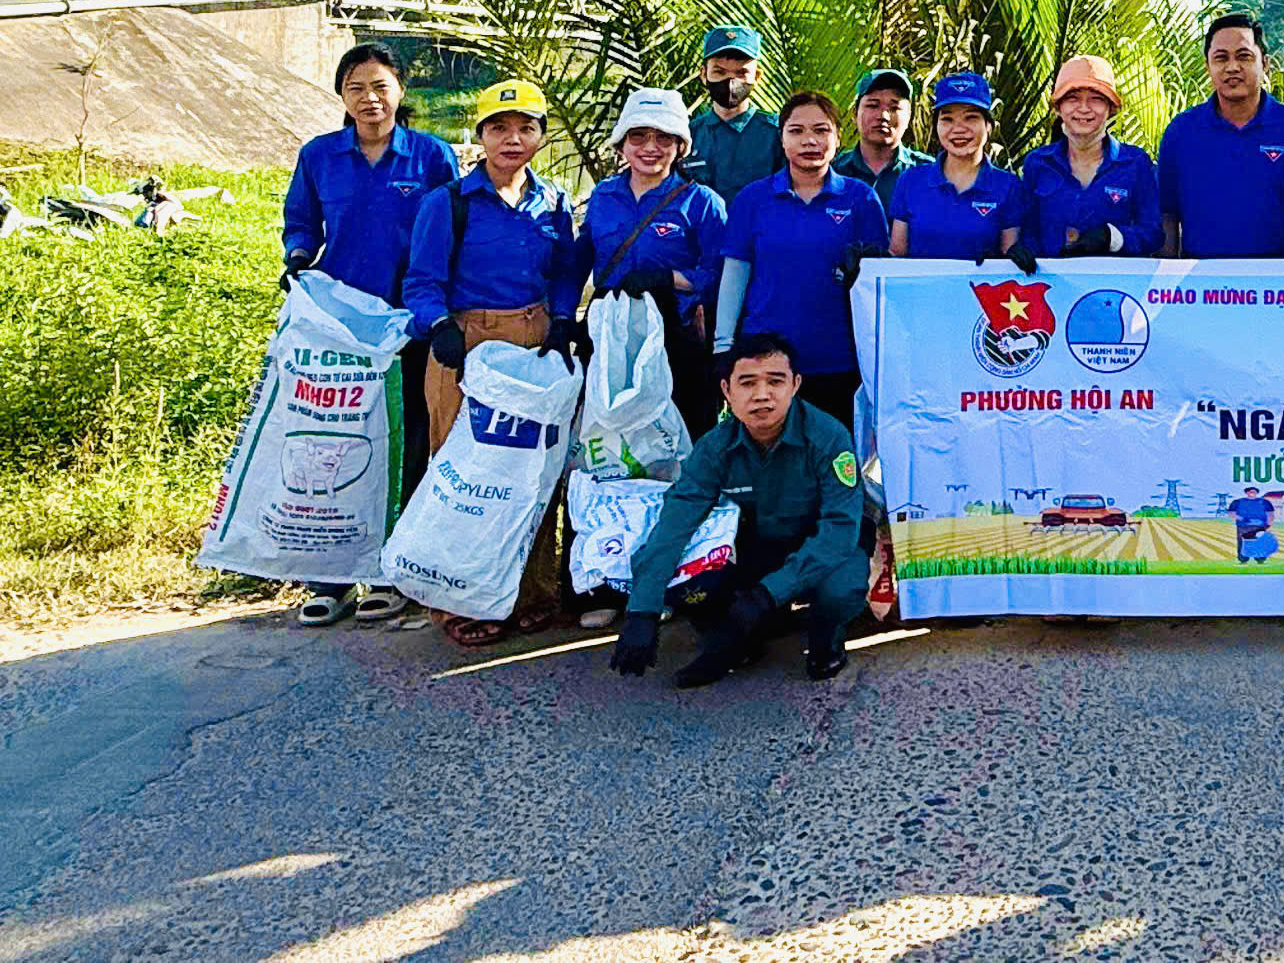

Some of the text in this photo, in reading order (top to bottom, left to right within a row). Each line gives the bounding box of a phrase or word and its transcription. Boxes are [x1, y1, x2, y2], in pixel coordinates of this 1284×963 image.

[1147, 286, 1197, 304] CHÀO
[1203, 285, 1258, 305] MỪNG
[1082, 347, 1112, 356] THANH
[1110, 356, 1130, 364] NAM
[294, 379, 364, 408] MH912
[961, 384, 1154, 413] PHƯỜNG HỘI AN
